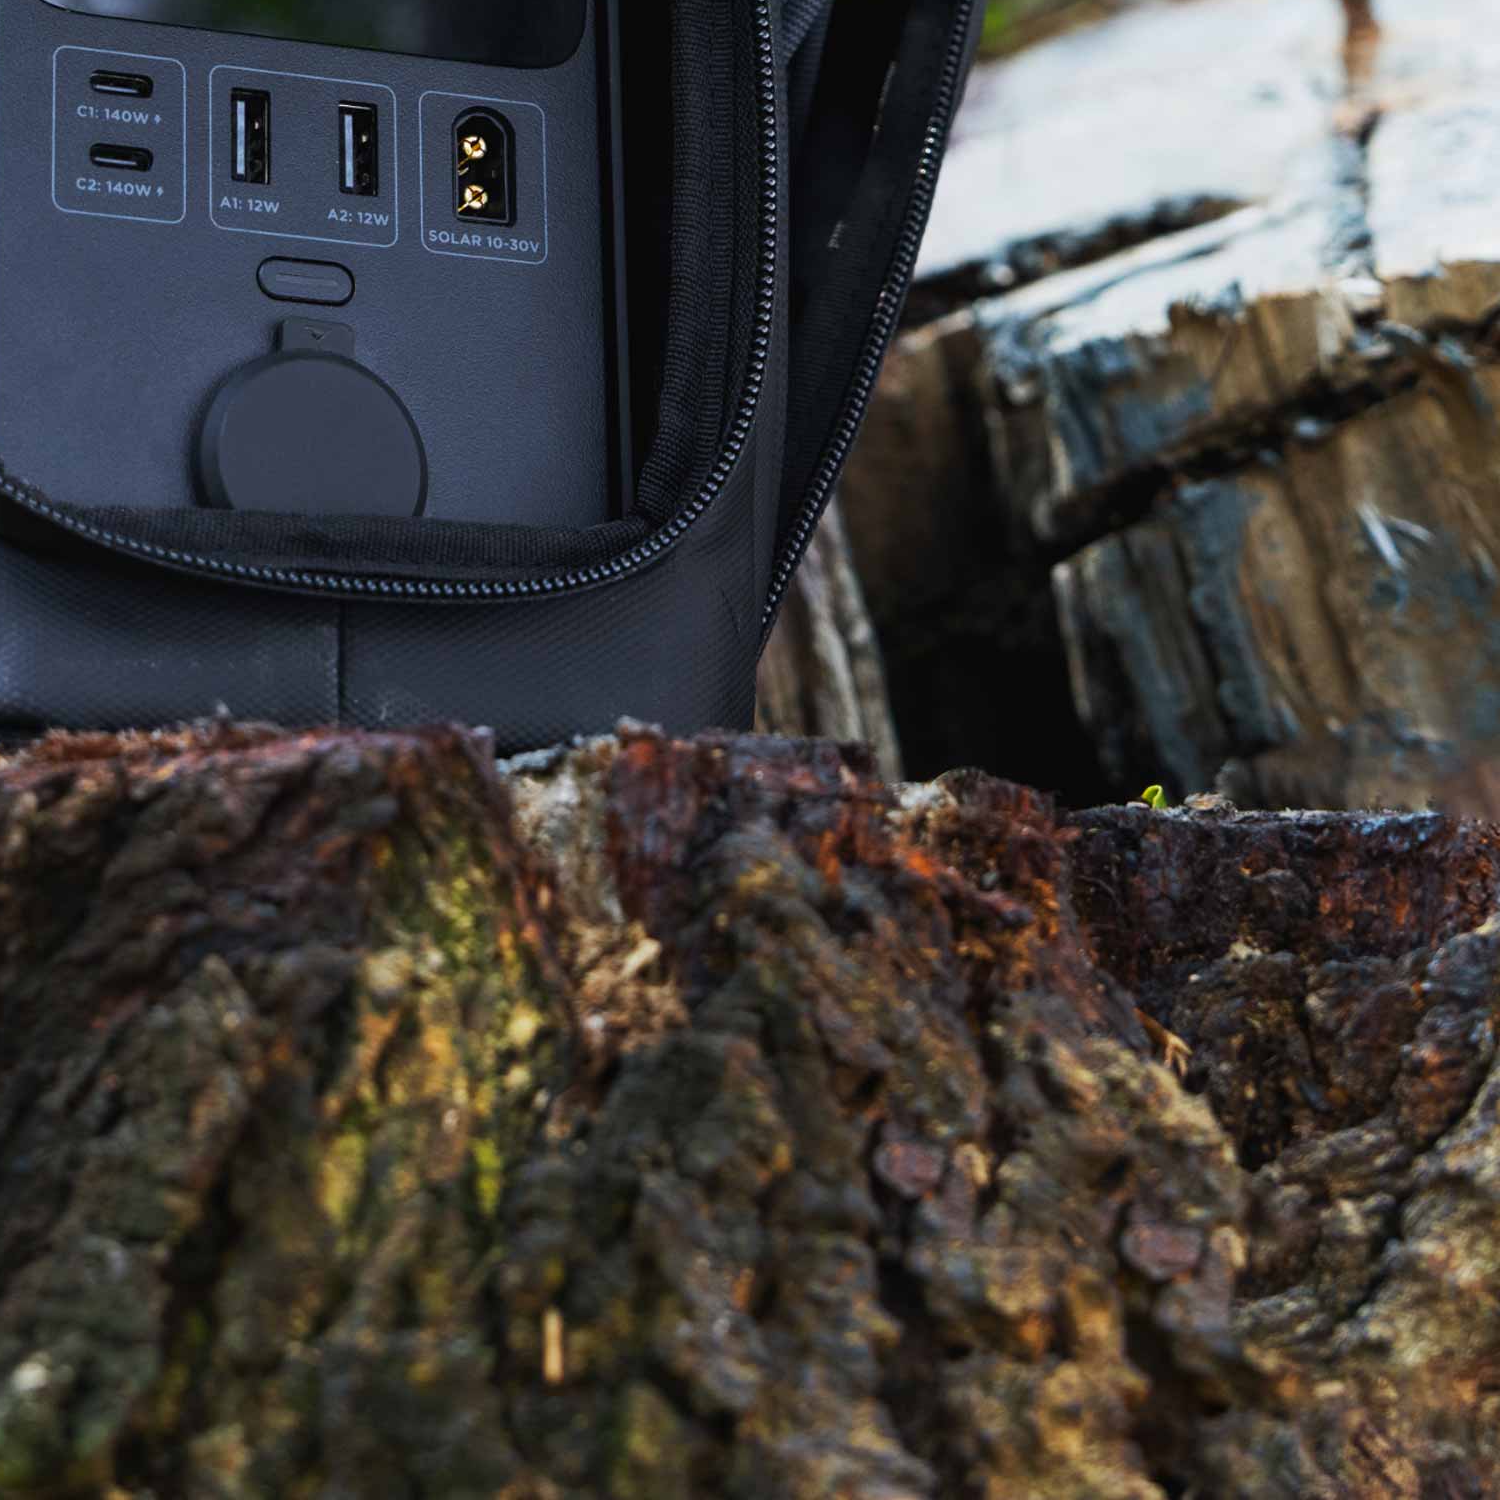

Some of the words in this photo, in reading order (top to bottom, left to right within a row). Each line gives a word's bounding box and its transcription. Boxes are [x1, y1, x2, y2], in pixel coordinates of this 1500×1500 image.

[77, 105, 99, 118] C1:
[104, 108, 149, 124] 140W
[76, 178, 101, 192] C2:
[106, 181, 152, 197] 140W
[220, 196, 242, 211] A1:
[248, 198, 280, 214] 12W
[327, 209, 353, 223] A2:
[357, 212, 389, 227] 12W
[428, 229, 482, 248] SOLAR
[486, 236, 540, 254] 10-30V
